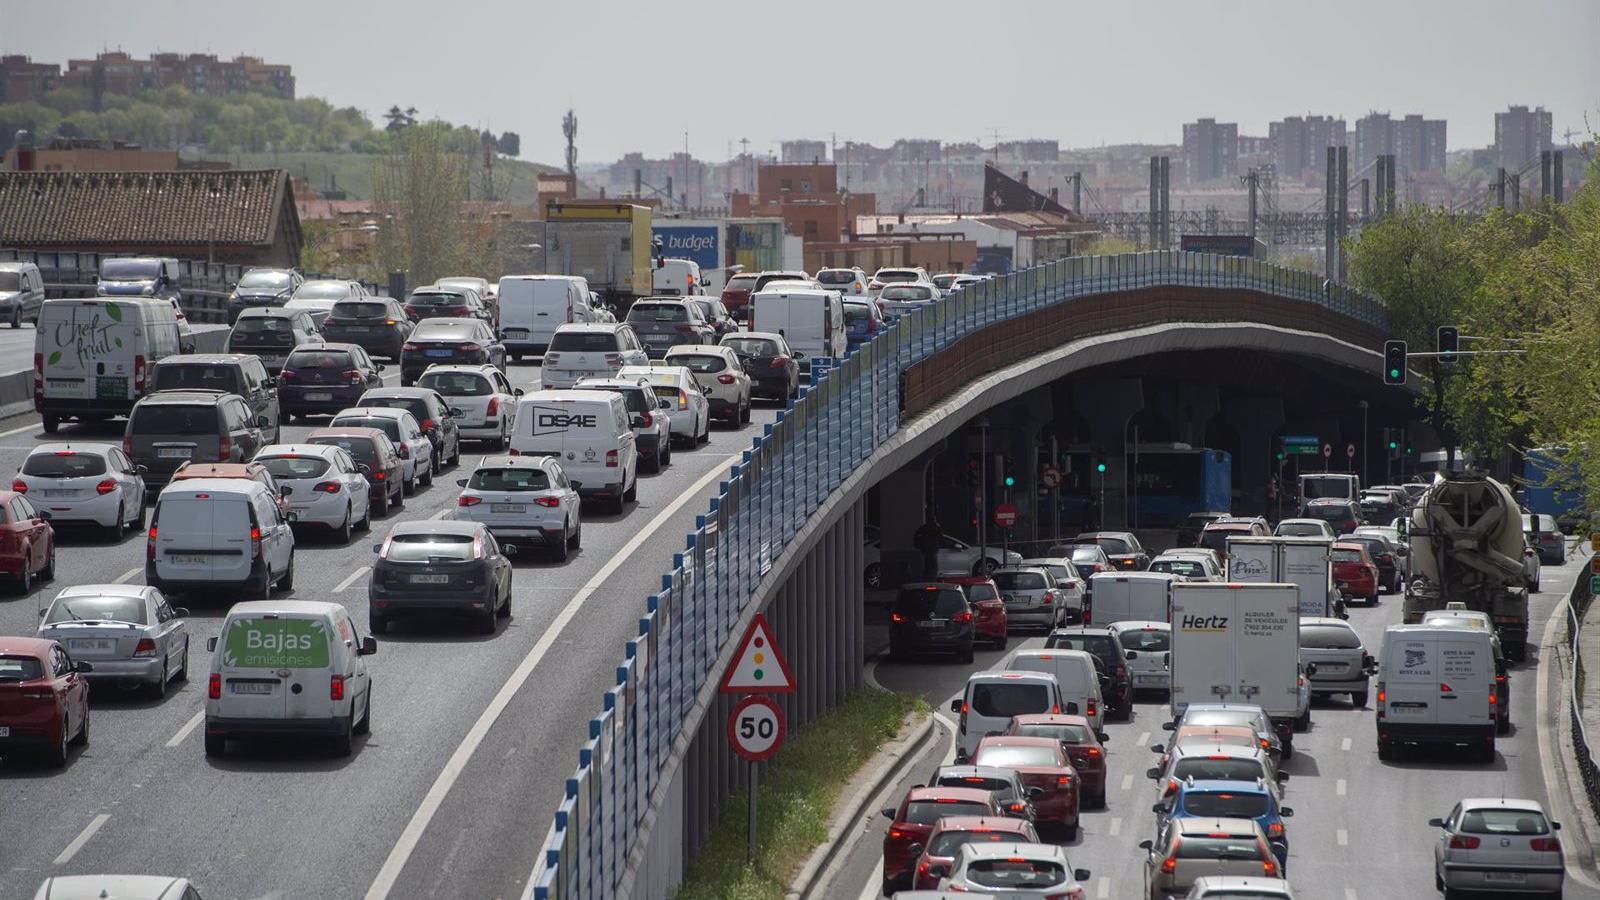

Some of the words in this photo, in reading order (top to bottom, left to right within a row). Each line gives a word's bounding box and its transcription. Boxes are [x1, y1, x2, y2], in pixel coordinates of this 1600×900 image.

[669, 235, 714, 251] budget
[55, 306, 100, 348] Chef
[539, 415, 596, 427] DS4E
[1182, 615, 1228, 628] Hertz
[247, 630, 310, 652] Bajas
[245, 655, 311, 665] emisiones
[741, 717, 773, 739] 50
